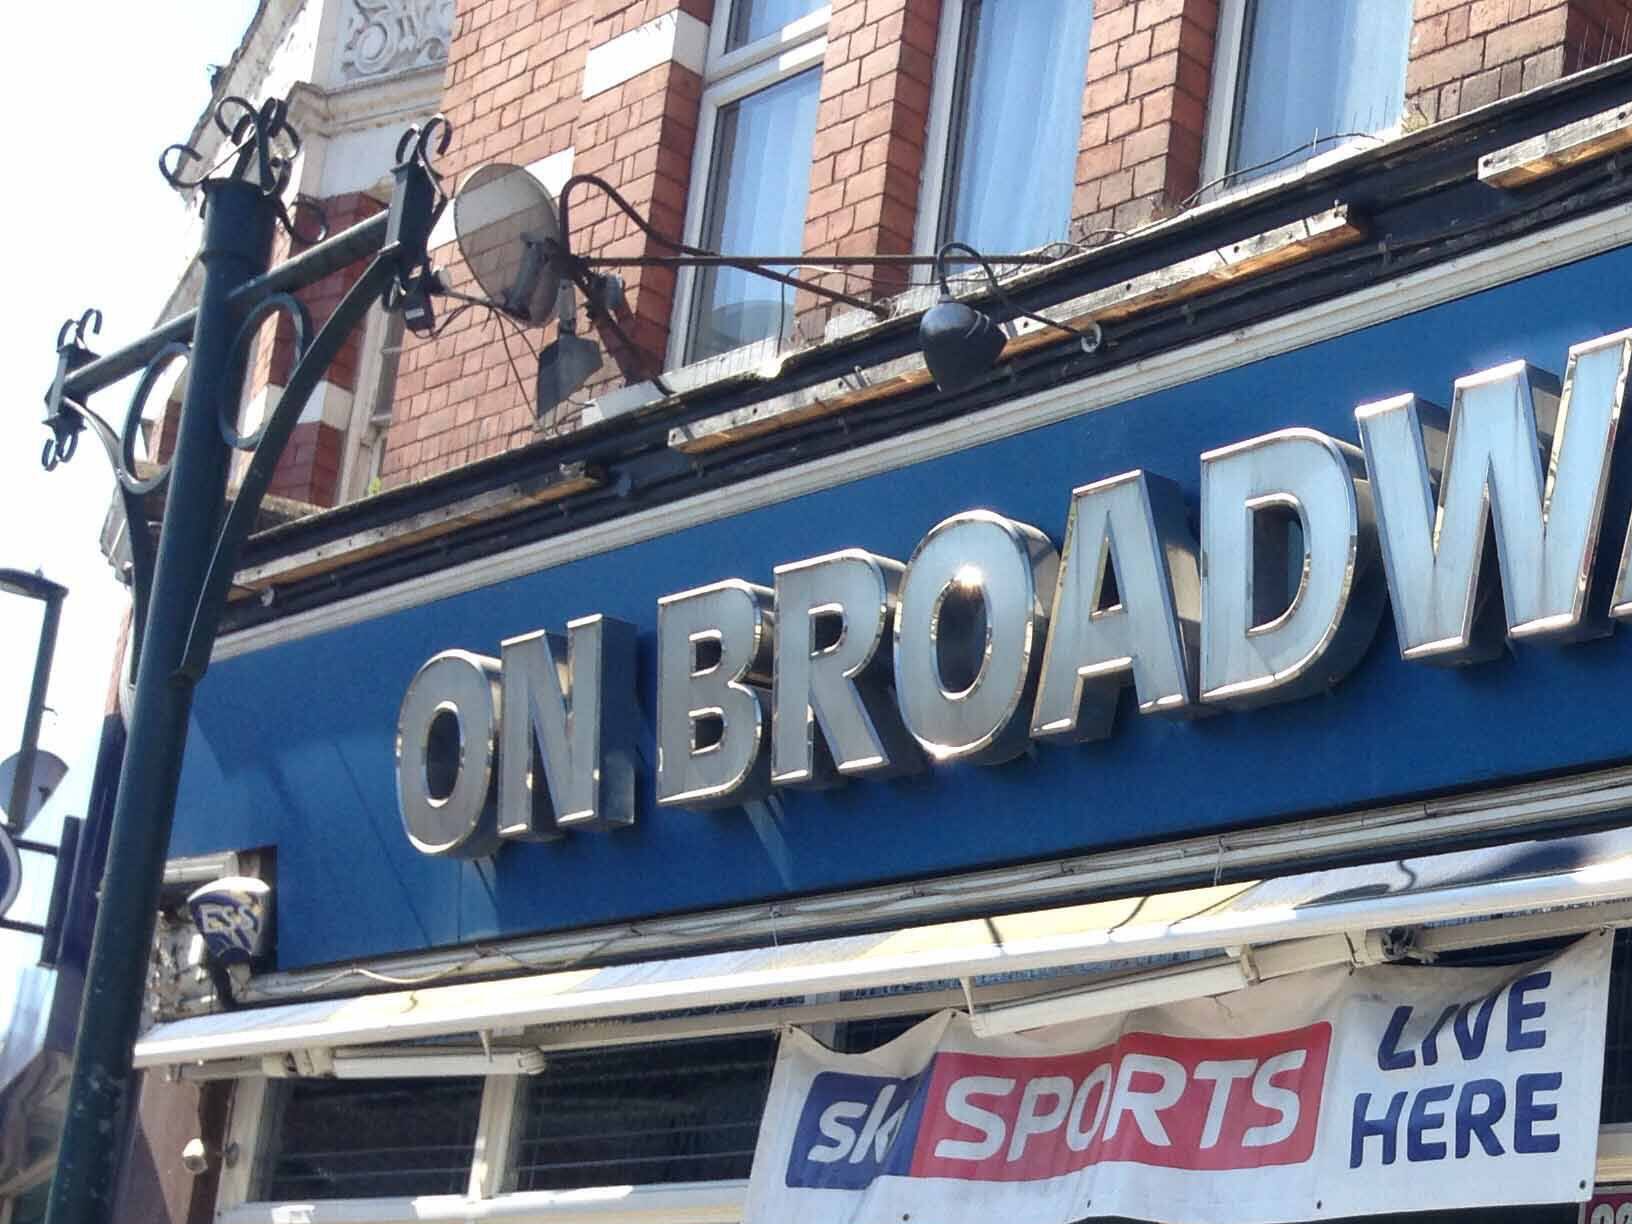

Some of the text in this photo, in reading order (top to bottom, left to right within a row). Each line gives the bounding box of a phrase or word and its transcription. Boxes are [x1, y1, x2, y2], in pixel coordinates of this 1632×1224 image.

[396, 613, 610, 857] ON
[1377, 971, 1552, 1071] LIVE
[934, 1048, 1309, 1163] SPORTS
[1349, 1071, 1564, 1169] HERE
